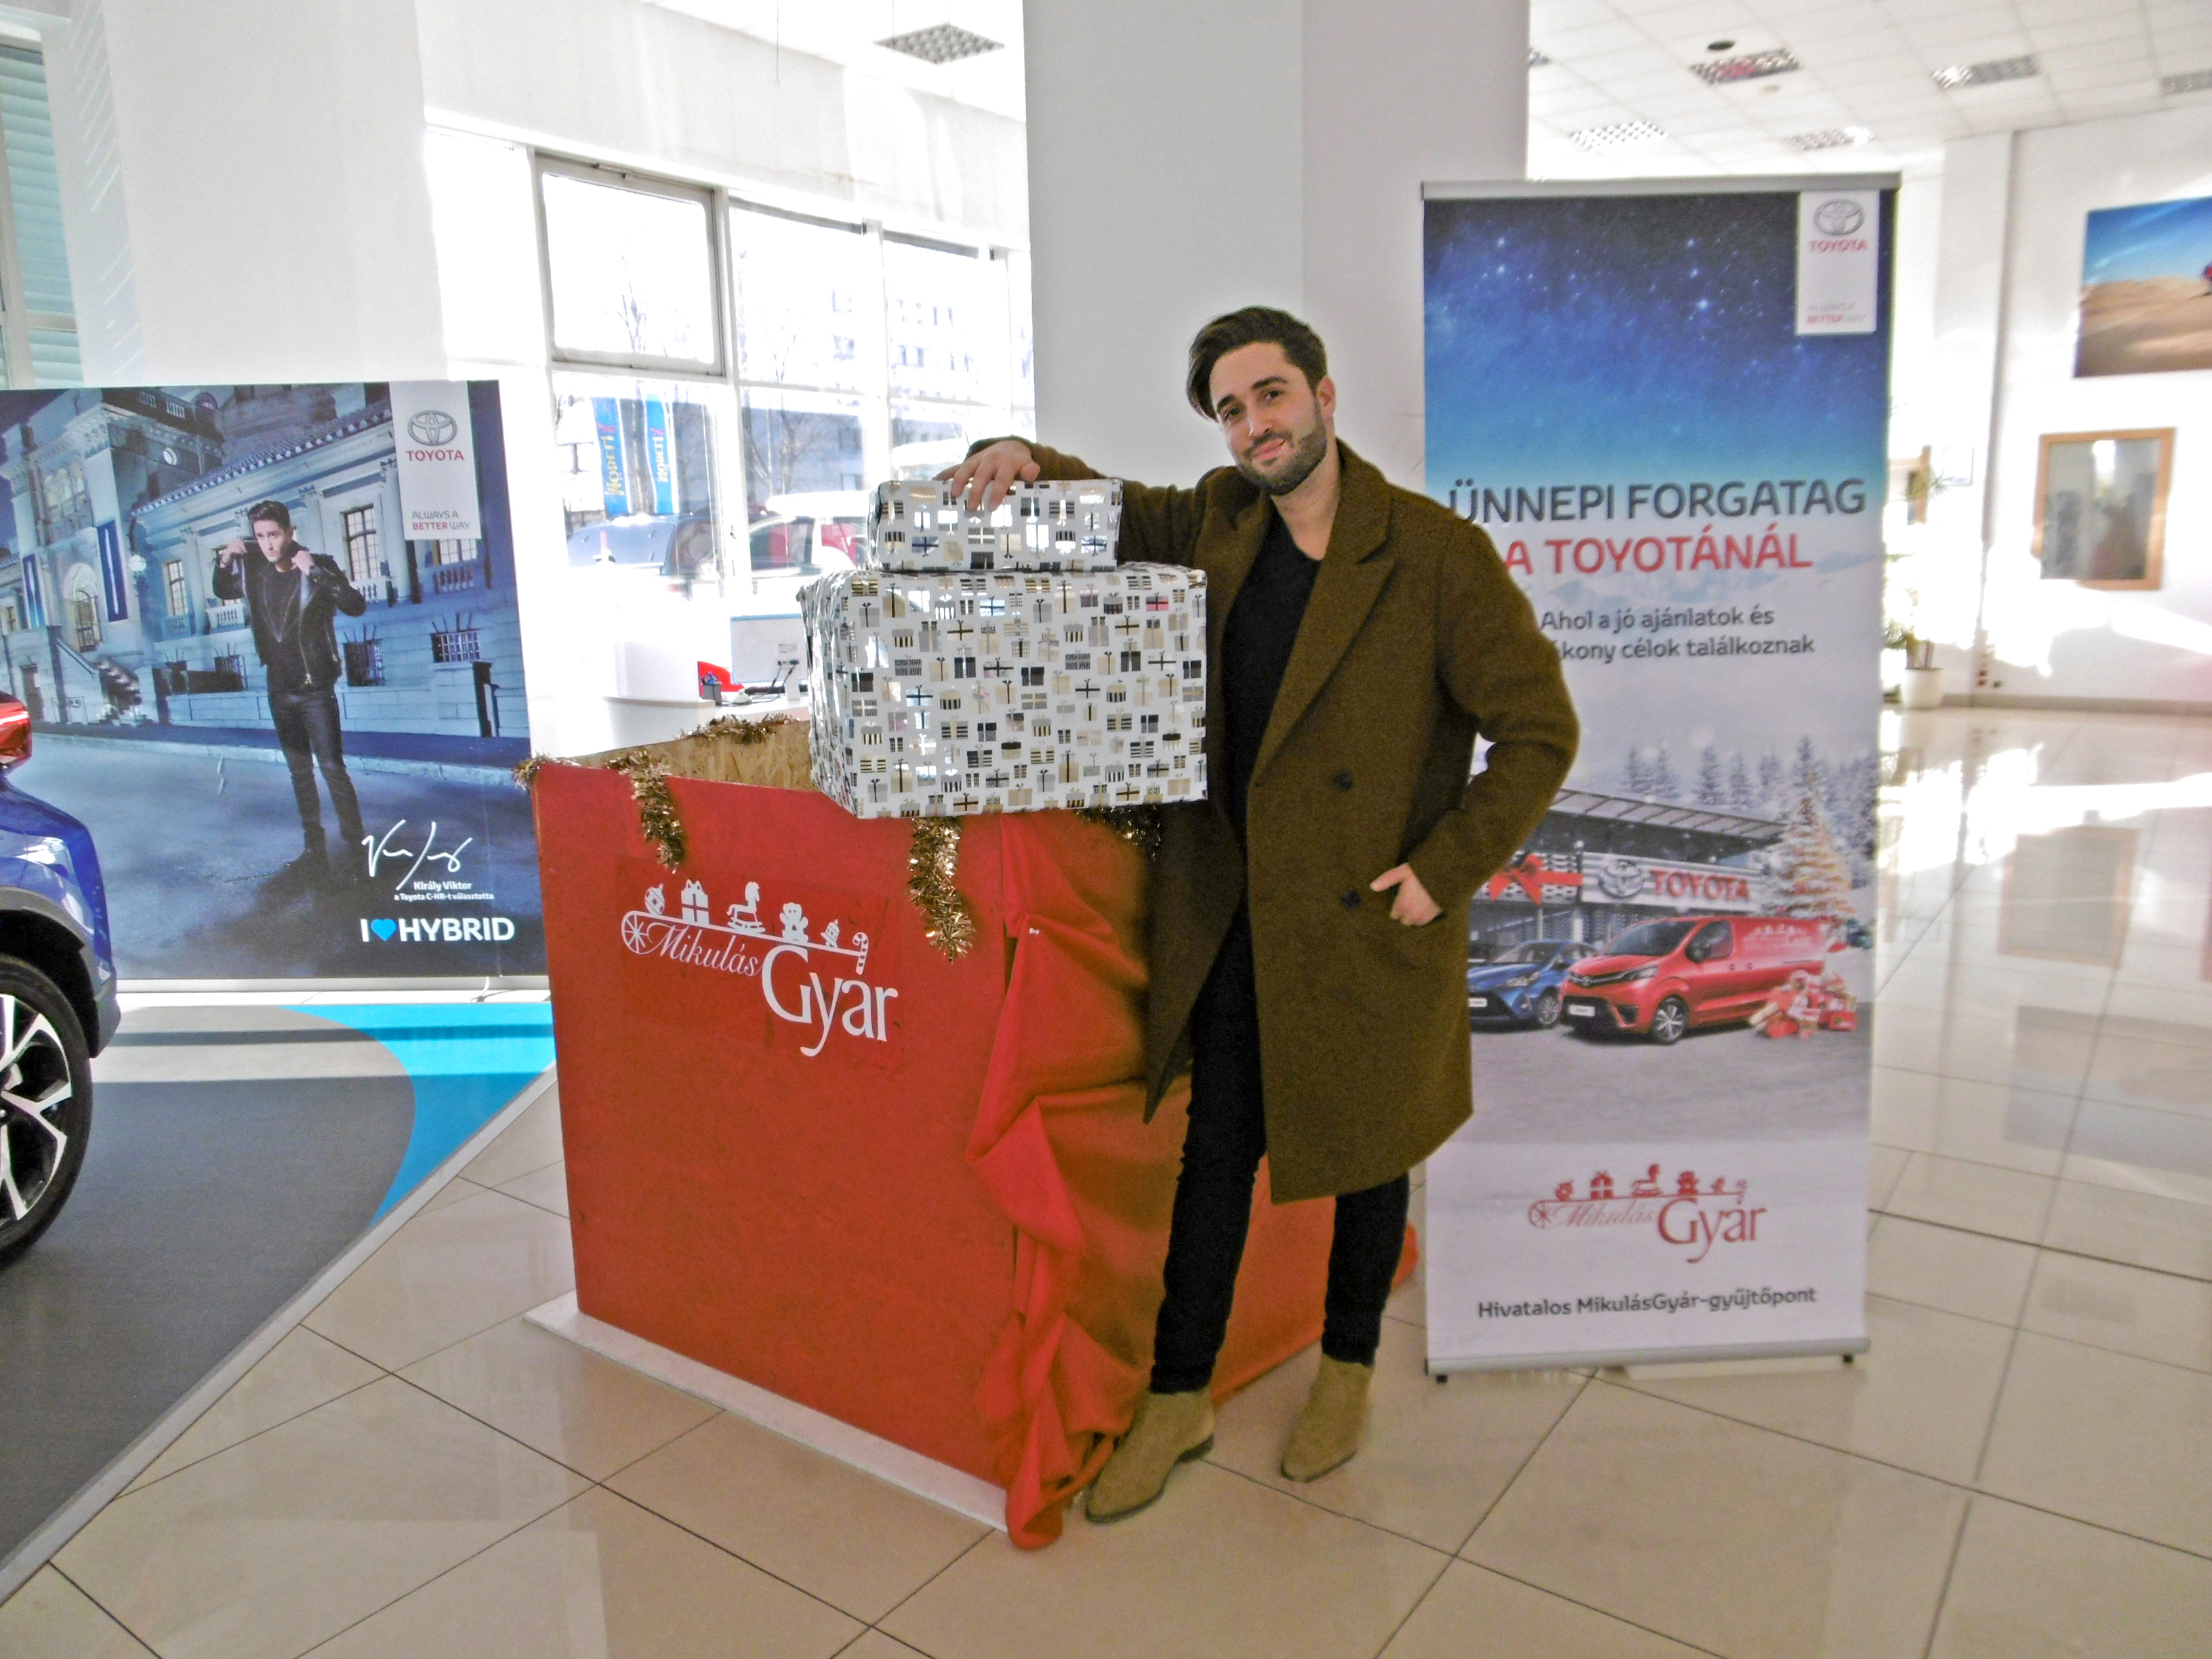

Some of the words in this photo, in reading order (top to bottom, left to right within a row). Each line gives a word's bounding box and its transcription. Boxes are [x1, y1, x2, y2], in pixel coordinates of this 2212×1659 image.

[1809, 240, 1868, 252] TOYOTA
[406, 449, 464, 462] TOYOTA
[1449, 478, 1614, 524] ÜNNEPI
[1629, 478, 1867, 519] FORGATAG
[412, 511, 450, 519] ALWAYS
[452, 510, 459, 518] A
[413, 522, 448, 531] BETTER
[449, 521, 470, 529] WAY
[1504, 540, 1534, 575] A
[1545, 523, 1814, 574] TOYOTÁNÁL
[1540, 610, 1592, 630] Ahol
[1598, 614, 1610, 629] a
[1613, 608, 1635, 634] jó
[1641, 606, 1744, 633] ajánlatok
[1750, 602, 1775, 624] és
[1622, 636, 1681, 658] célok
[1687, 634, 1815, 657] találkoznak
[400, 893, 426, 902] Toyota
[413, 881, 441, 892] Király
[443, 881, 472, 890] Viktor
[1650, 869, 1750, 901] TOYOTA
[360, 918, 369, 943] I
[398, 917, 515, 942] HYBRID
[647, 922, 764, 977] Mikulás
[1552, 1200, 1656, 1228] Mikulás
[1478, 1298, 1572, 1319] Hivatalos
[1577, 1286, 1817, 1315] MikulásGyár-gyűjtőpont
